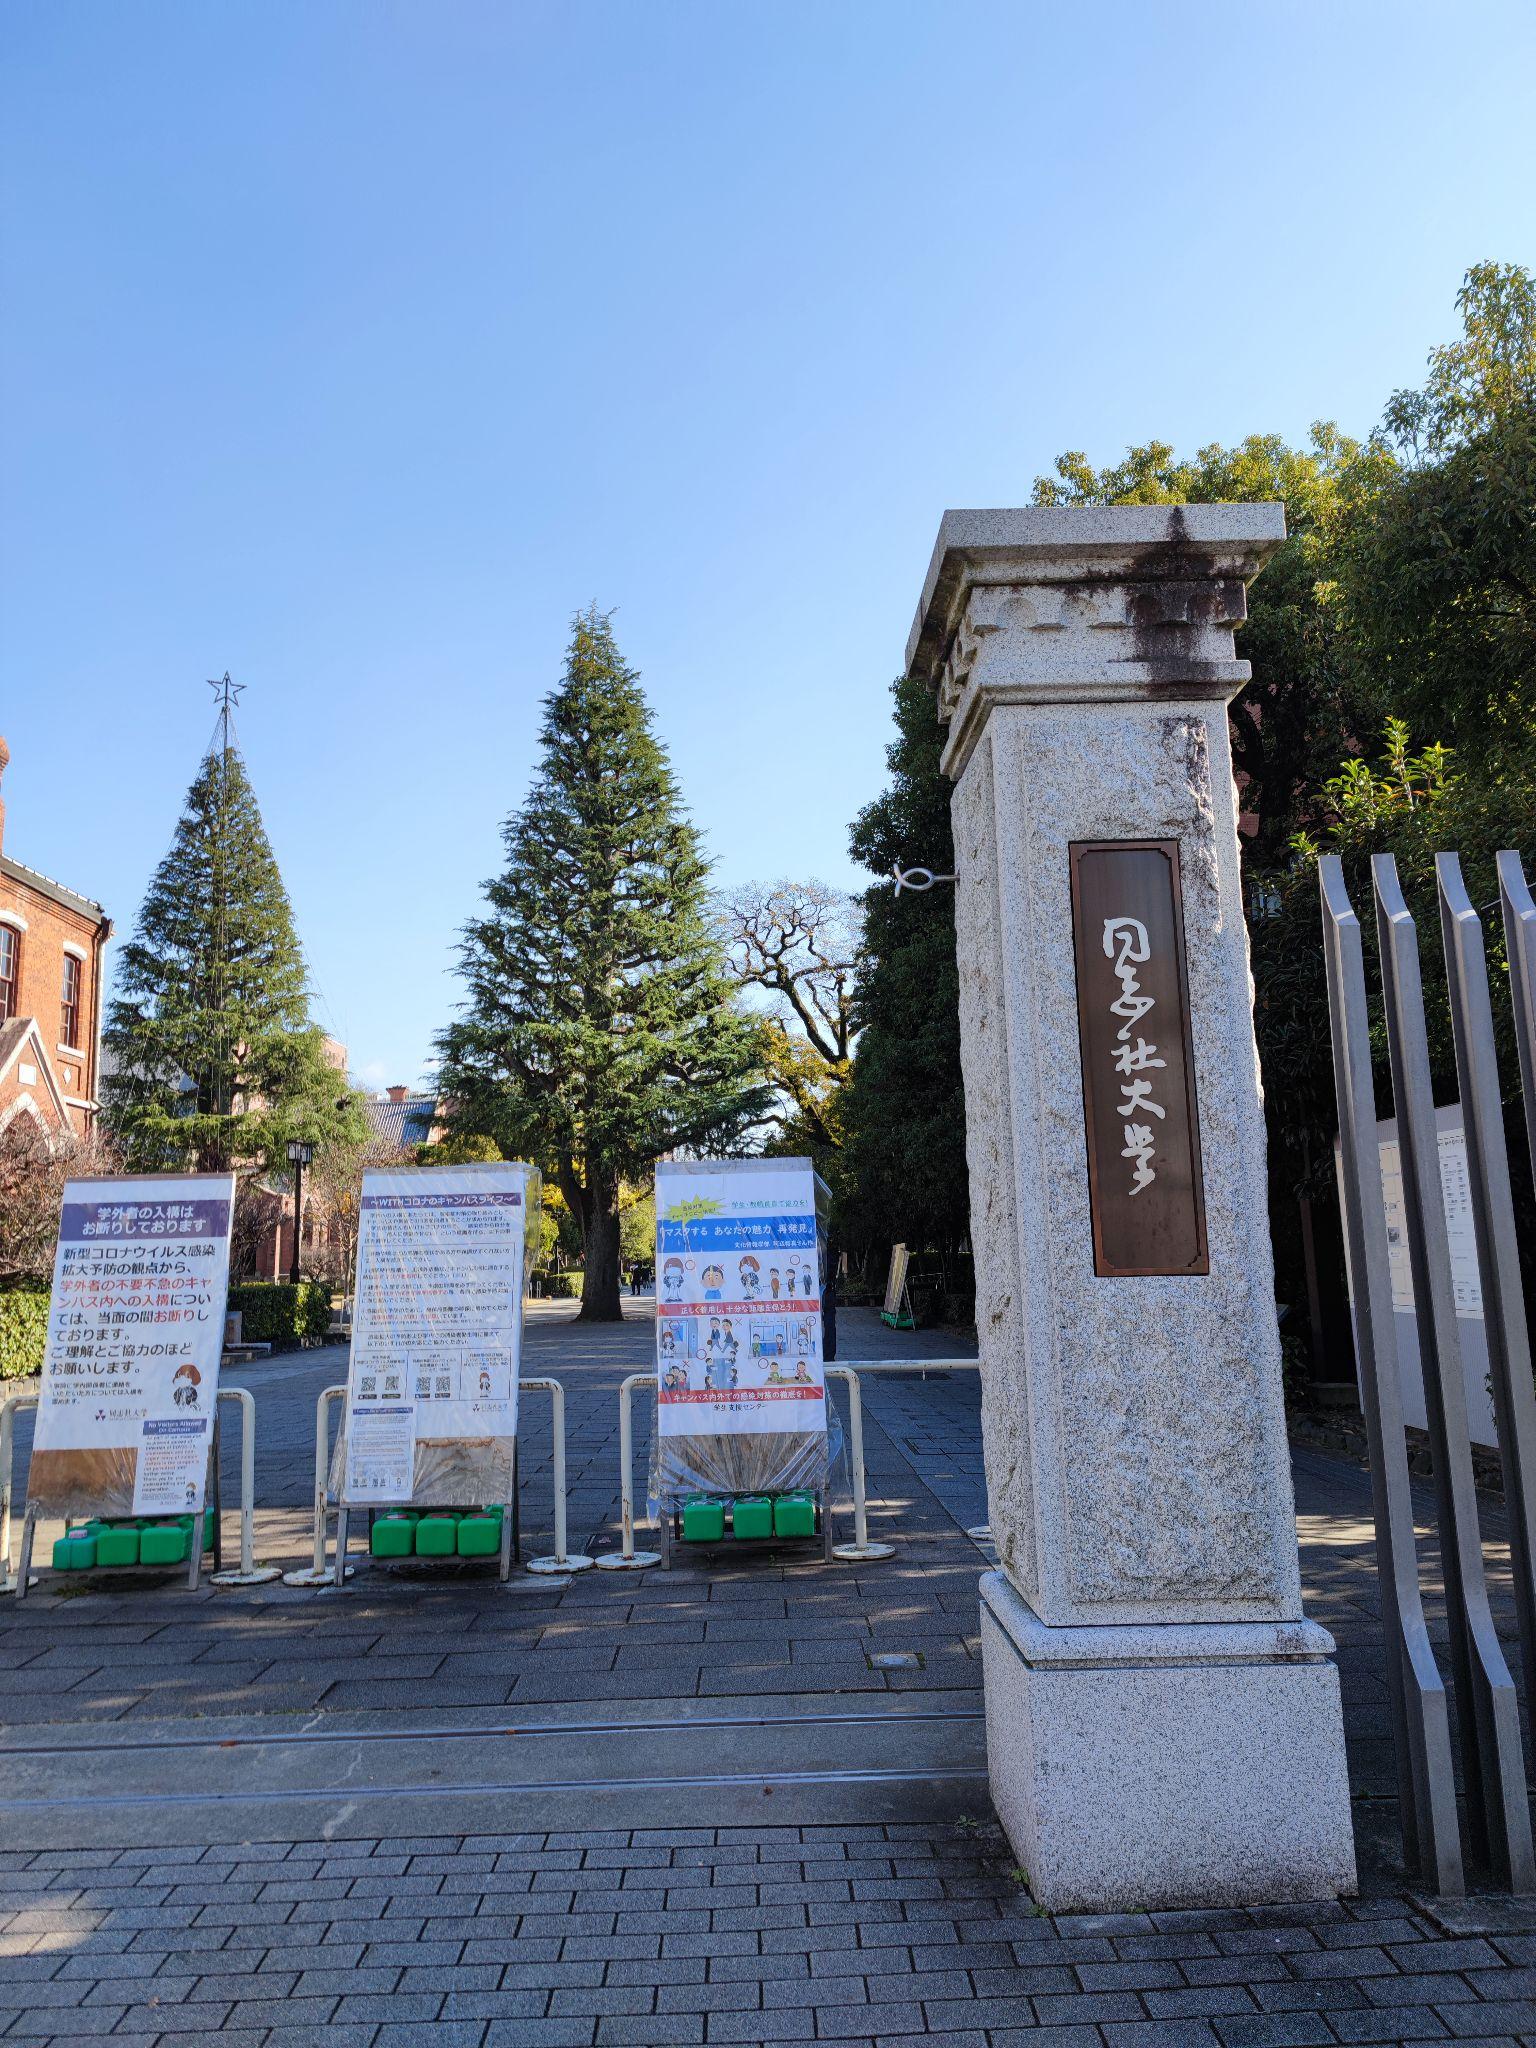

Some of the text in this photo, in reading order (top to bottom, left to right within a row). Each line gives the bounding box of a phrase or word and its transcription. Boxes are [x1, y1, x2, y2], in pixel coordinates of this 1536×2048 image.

[97, 1205, 194, 1220] 学外者の入構は
[82, 1219, 206, 1236] お断りしております
[714, 1224, 772, 1235] あなたの魅力
[64, 1245, 215, 1260] 新型コロナウイルス感染
[61, 1262, 191, 1277] 拡大予防の観点から、
[60, 1277, 211, 1293] 学外者の不要不急のキャ
[56, 1309, 209, 1326] ては、当面の間お断りし
[54, 1328, 130, 1342] ております。
[51, 1342, 193, 1359] ご理解とご協力のほど
[50, 1360, 140, 1376] お願いします。
